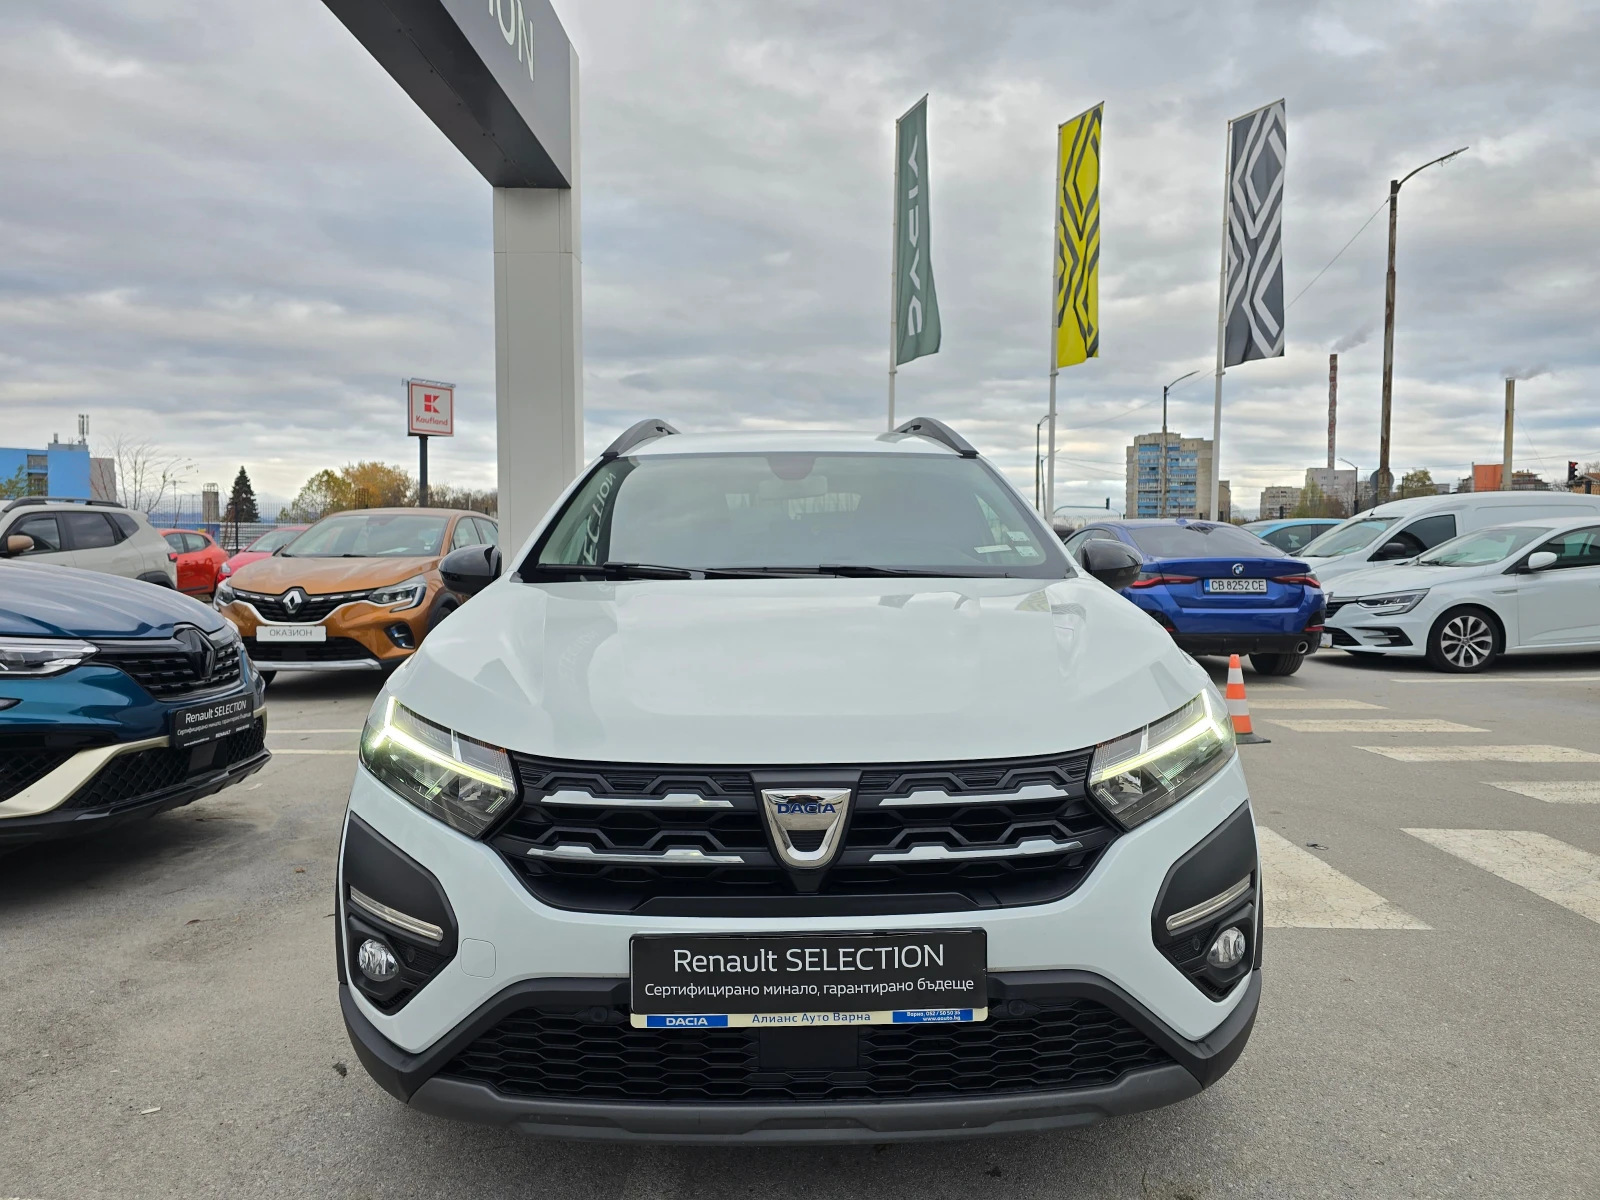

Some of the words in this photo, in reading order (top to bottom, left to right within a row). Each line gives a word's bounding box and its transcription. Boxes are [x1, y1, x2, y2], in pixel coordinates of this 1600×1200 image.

[489, 0, 534, 81] ON
[416, 415, 449, 426] Kaufland
[1226, 580, 1251, 591] 8252
[269, 629, 313, 637] ОКАЗИОН
[185, 708, 214, 724] Renault
[214, 700, 247, 718] SELECTION
[215, 729, 231, 738] RENAULT
[777, 803, 836, 815] DACIA
[673, 948, 778, 973] Renault
[786, 943, 944, 973] SELECTION
[645, 982, 760, 999] Сертифицирано
[763, 984, 821, 997] минало,
[823, 980, 914, 998] гарантирано
[917, 977, 975, 992] бъдеще
[665, 1017, 708, 1026] DACIA
[751, 1014, 798, 1024] Алианс
[801, 1013, 829, 1025] Ауто
[833, 1012, 871, 1022] Варна
